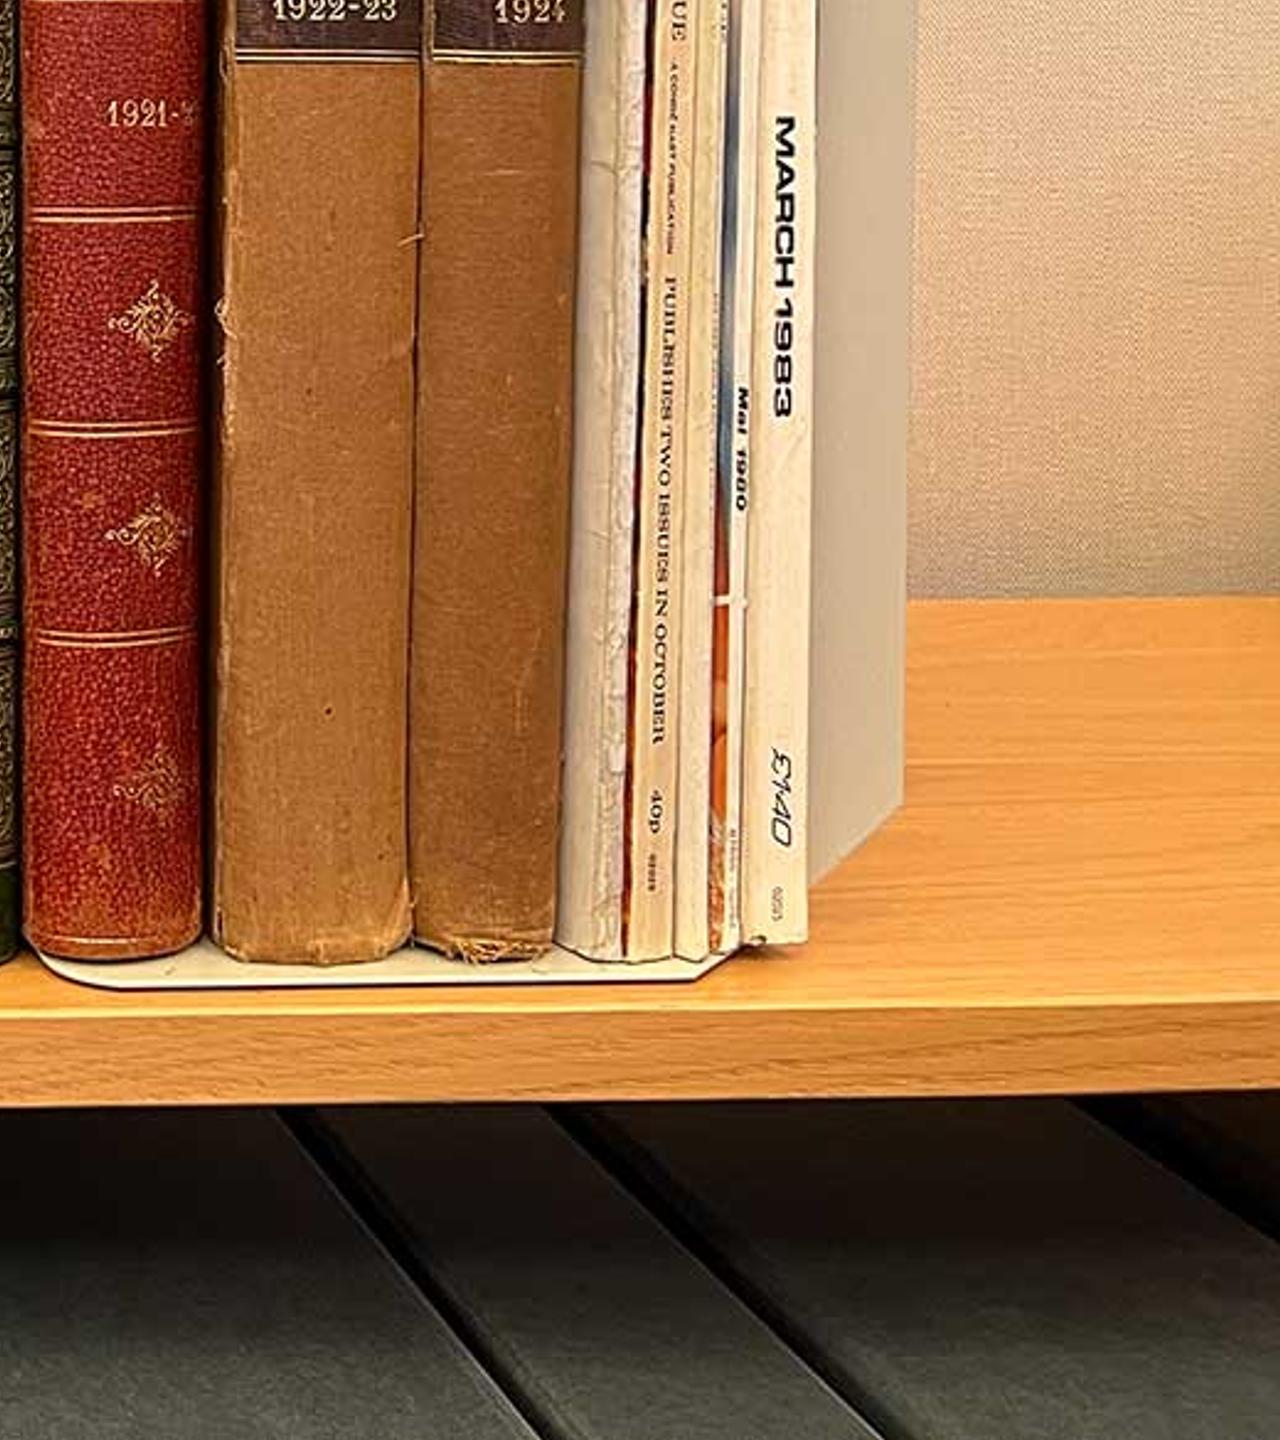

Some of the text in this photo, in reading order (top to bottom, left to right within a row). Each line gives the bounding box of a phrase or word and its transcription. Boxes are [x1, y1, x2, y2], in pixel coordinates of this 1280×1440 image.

[773, 116, 796, 418] MARCH 1983
[658, 429, 672, 488] TWO
[654, 589, 668, 617] IN
[652, 622, 668, 745] OCTOBER
